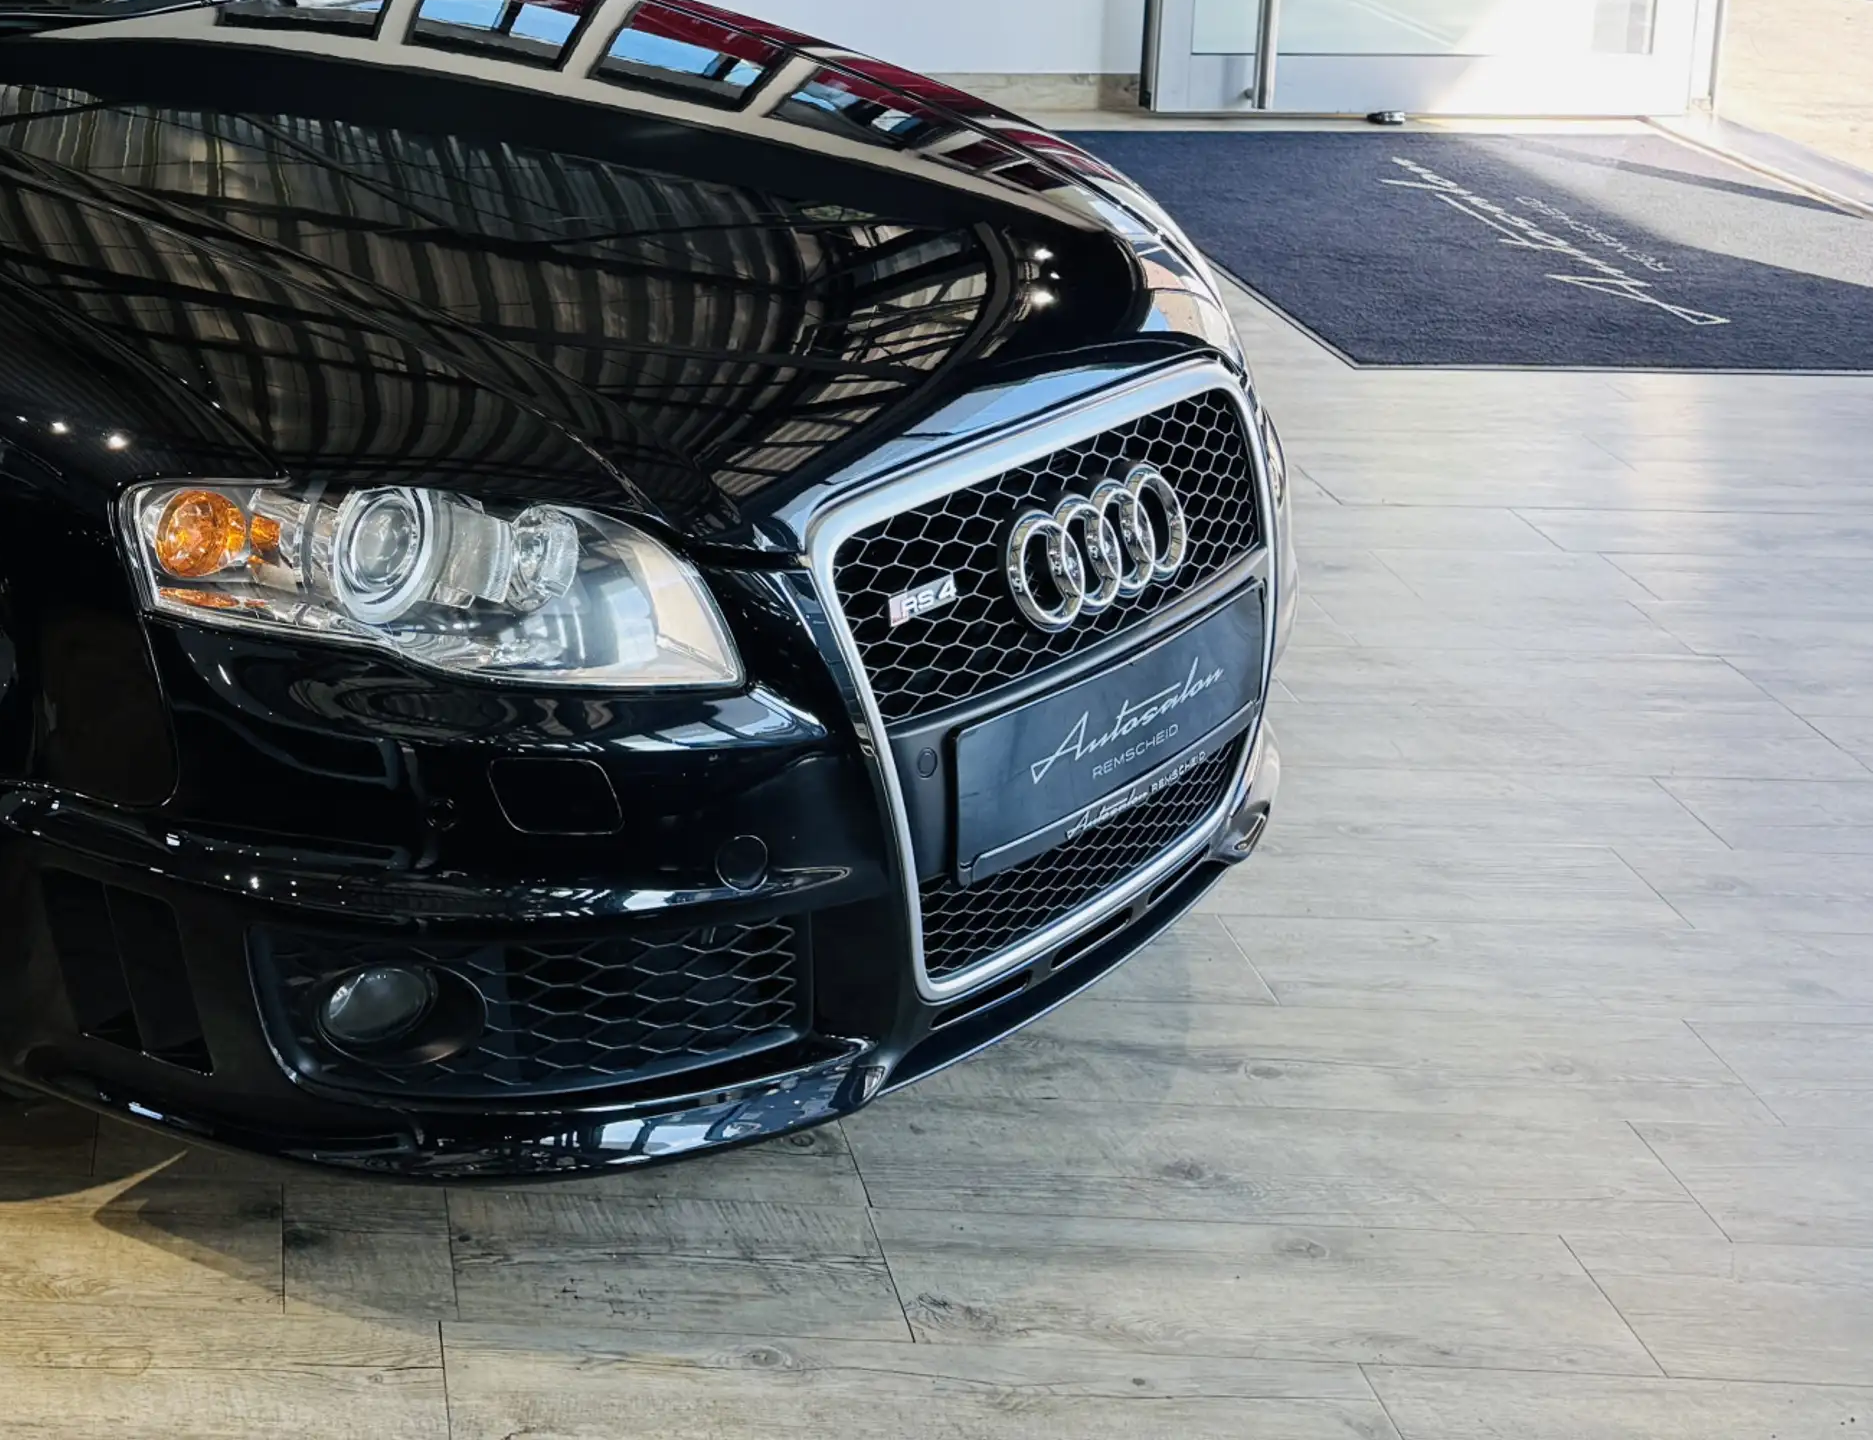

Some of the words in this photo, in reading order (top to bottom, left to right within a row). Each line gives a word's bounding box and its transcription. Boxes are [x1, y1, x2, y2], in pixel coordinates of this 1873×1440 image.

[1030, 656, 1224, 784] Autosalon
[1091, 723, 1179, 779] REMSCHEID
[1150, 750, 1207, 793] REMSCHEID
